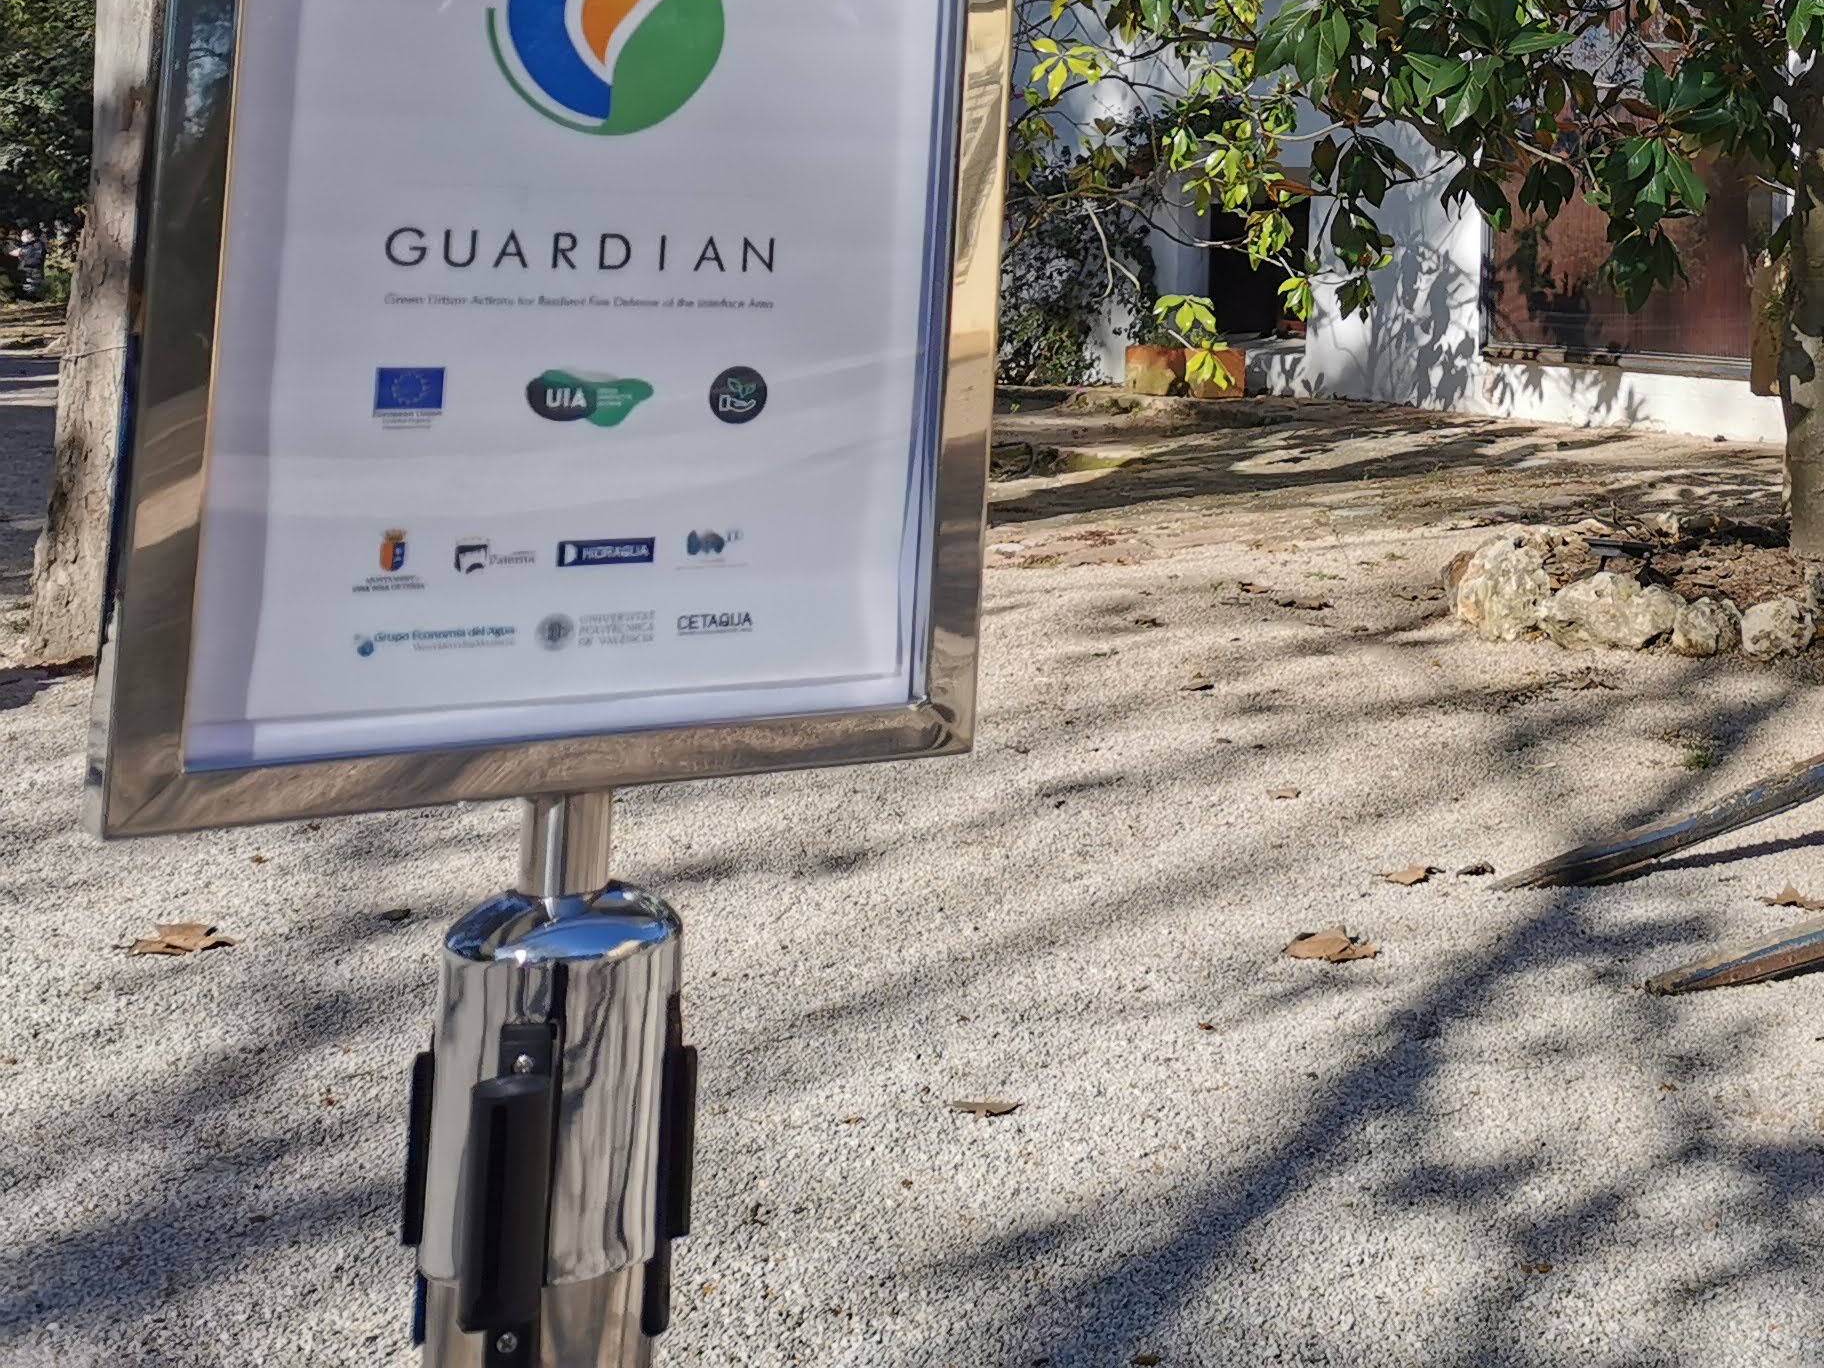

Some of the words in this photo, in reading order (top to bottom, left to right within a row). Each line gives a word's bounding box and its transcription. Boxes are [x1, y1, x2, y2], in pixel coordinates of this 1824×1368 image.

[386, 226, 775, 273] GUARDIAN
[545, 387, 587, 409] UIA
[677, 612, 752, 630] CETAQUA
[374, 631, 409, 642] Grupo
[468, 626, 485, 637] del
